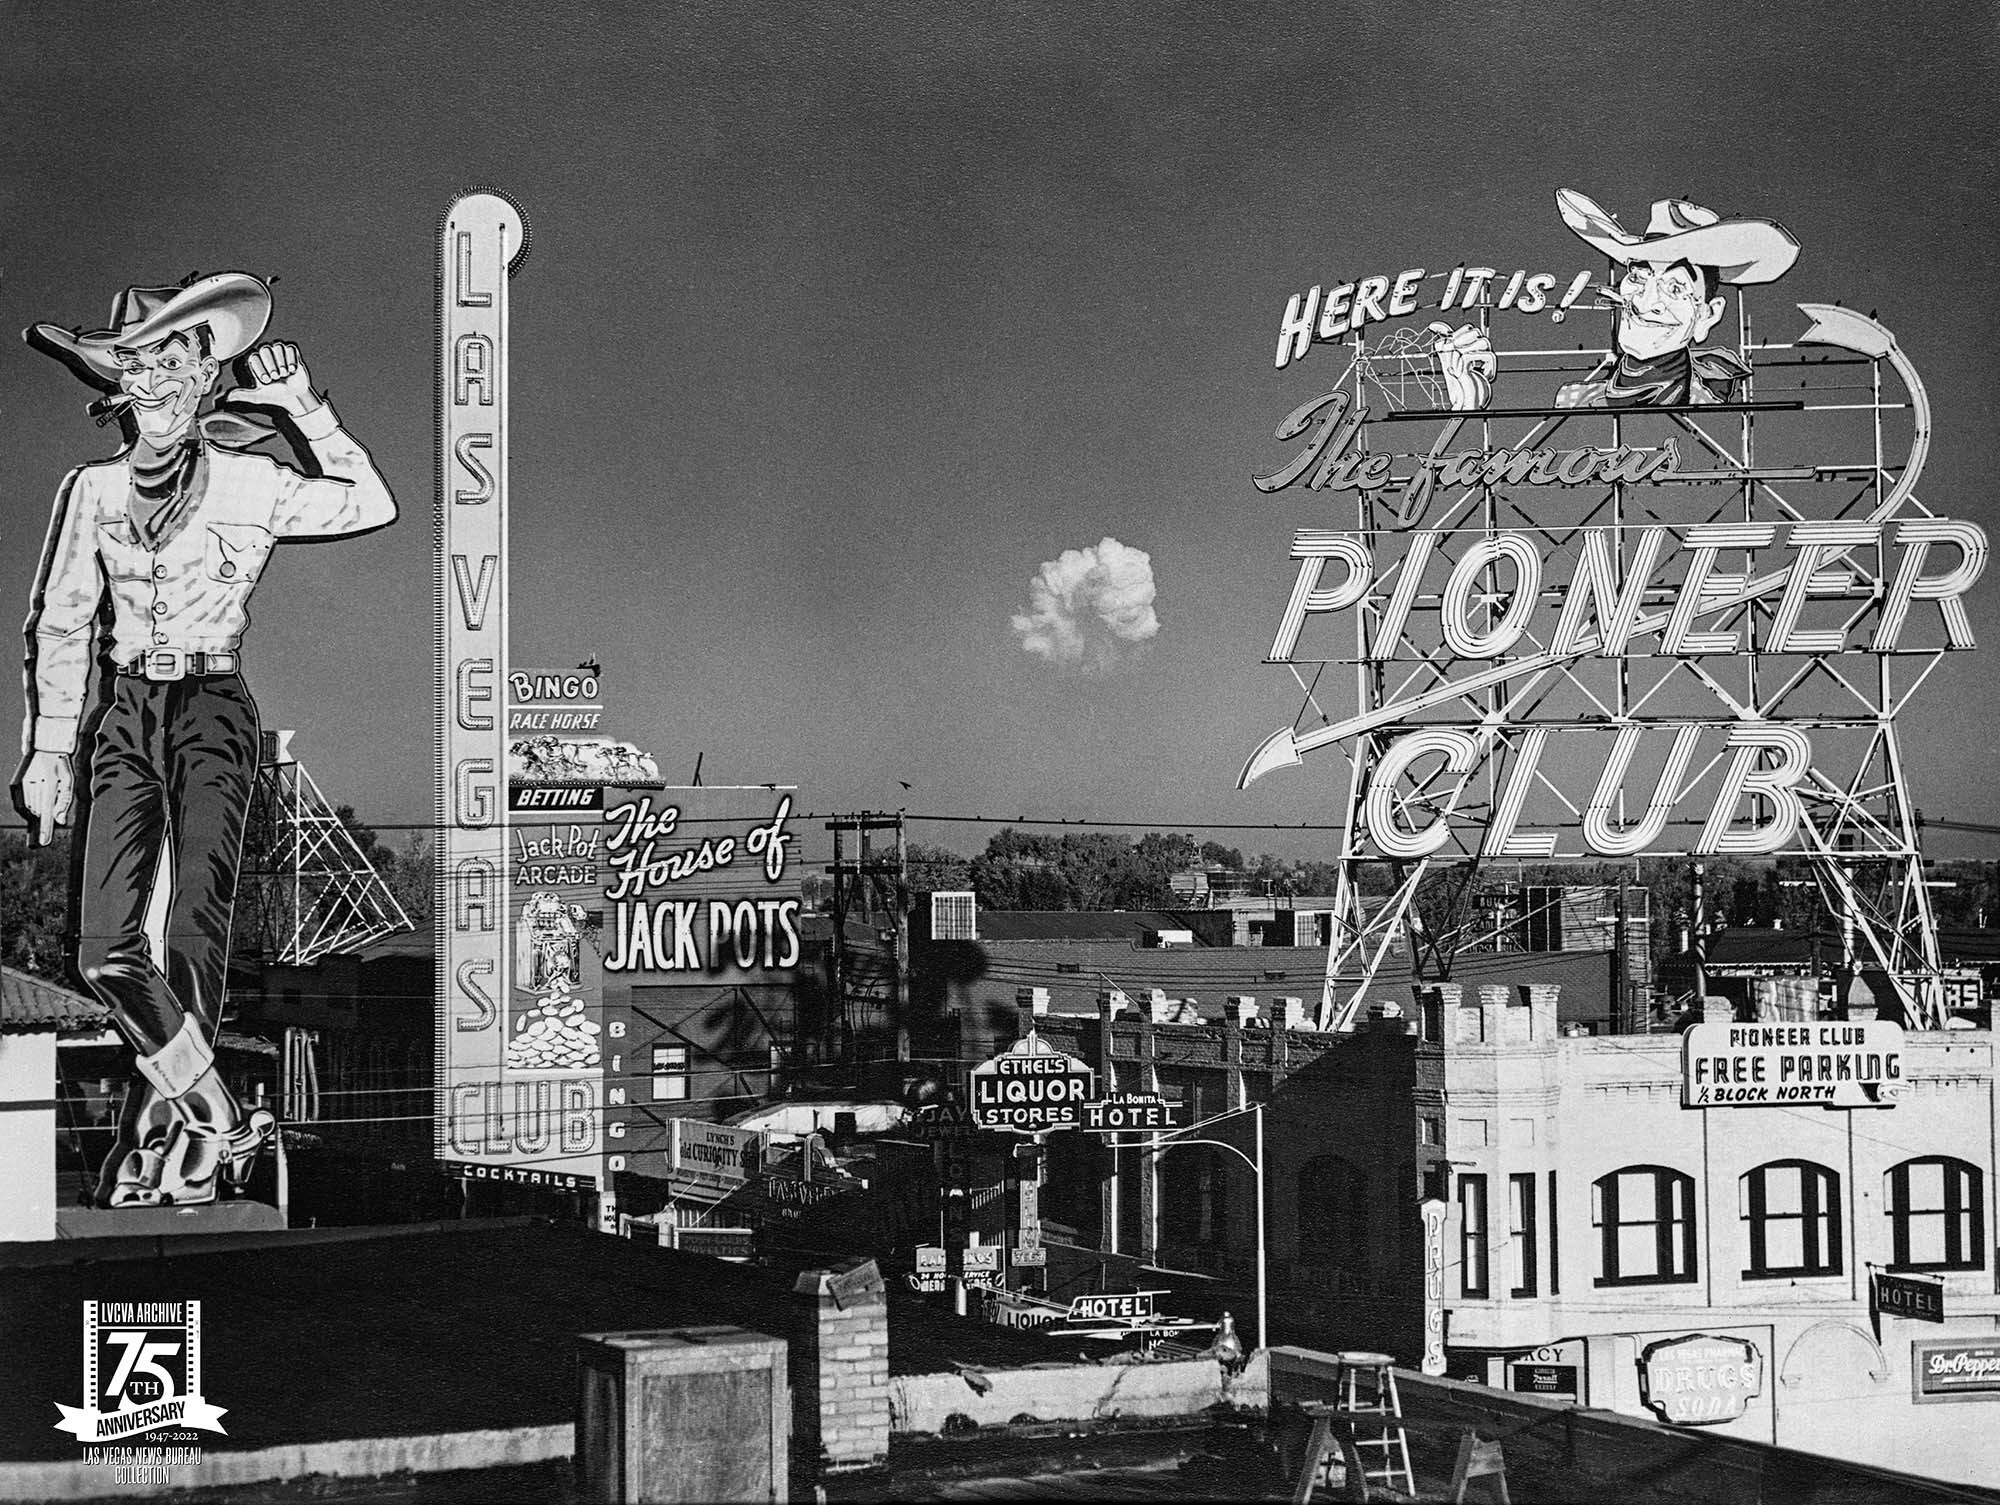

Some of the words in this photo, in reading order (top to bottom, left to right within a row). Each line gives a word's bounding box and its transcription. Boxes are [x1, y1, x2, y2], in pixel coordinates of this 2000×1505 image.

[1274, 267, 1426, 369] HERE
[1440, 267, 1496, 311] IT
[454, 231, 496, 505] LAS
[1252, 389, 1392, 493] The
[1398, 416, 1681, 530] famous
[1265, 519, 1989, 661] PIONEER
[508, 672, 599, 702] BINGO
[510, 713, 549, 730] RACE
[551, 713, 600, 730] HORSE
[451, 555, 497, 1033] VEGAS
[516, 788, 596, 807] BETTING
[1364, 725, 1812, 858] CLUB
[604, 796, 680, 851] The
[515, 824, 565, 863] Jack
[567, 824, 600, 860] Pot
[604, 838, 736, 900] House
[746, 795, 792, 881] of
[515, 865, 597, 886] ARCADE
[603, 901, 701, 971] JACK
[709, 900, 800, 970] POTS
[1730, 1027, 1811, 1047] PIONEER
[1820, 1027, 1865, 1046] CLUB
[1000, 1059, 1065, 1075] ETHEL'S
[1695, 1056, 1766, 1085] FREE
[1781, 1053, 1901, 1082] PARKING
[609, 1021, 627, 1172] BINGO
[981, 1079, 1085, 1104] LIQUOR
[1112, 1093, 1125, 1105] LA
[1714, 1087, 1768, 1101] BLOCK
[1776, 1085, 1836, 1100] NORTH
[451, 1081, 595, 1155] CLUB
[986, 1107, 1073, 1124] STORES
[1090, 1108, 1177, 1127] HOTEL
[463, 1165, 576, 1188] COCKTAILS
[1427, 1212, 1442, 1367] DRUGS
[1880, 1287, 1936, 1311] HOTEL
[1080, 1297, 1146, 1318] HOTEL
[1655, 1364, 1754, 1393] DRUGS
